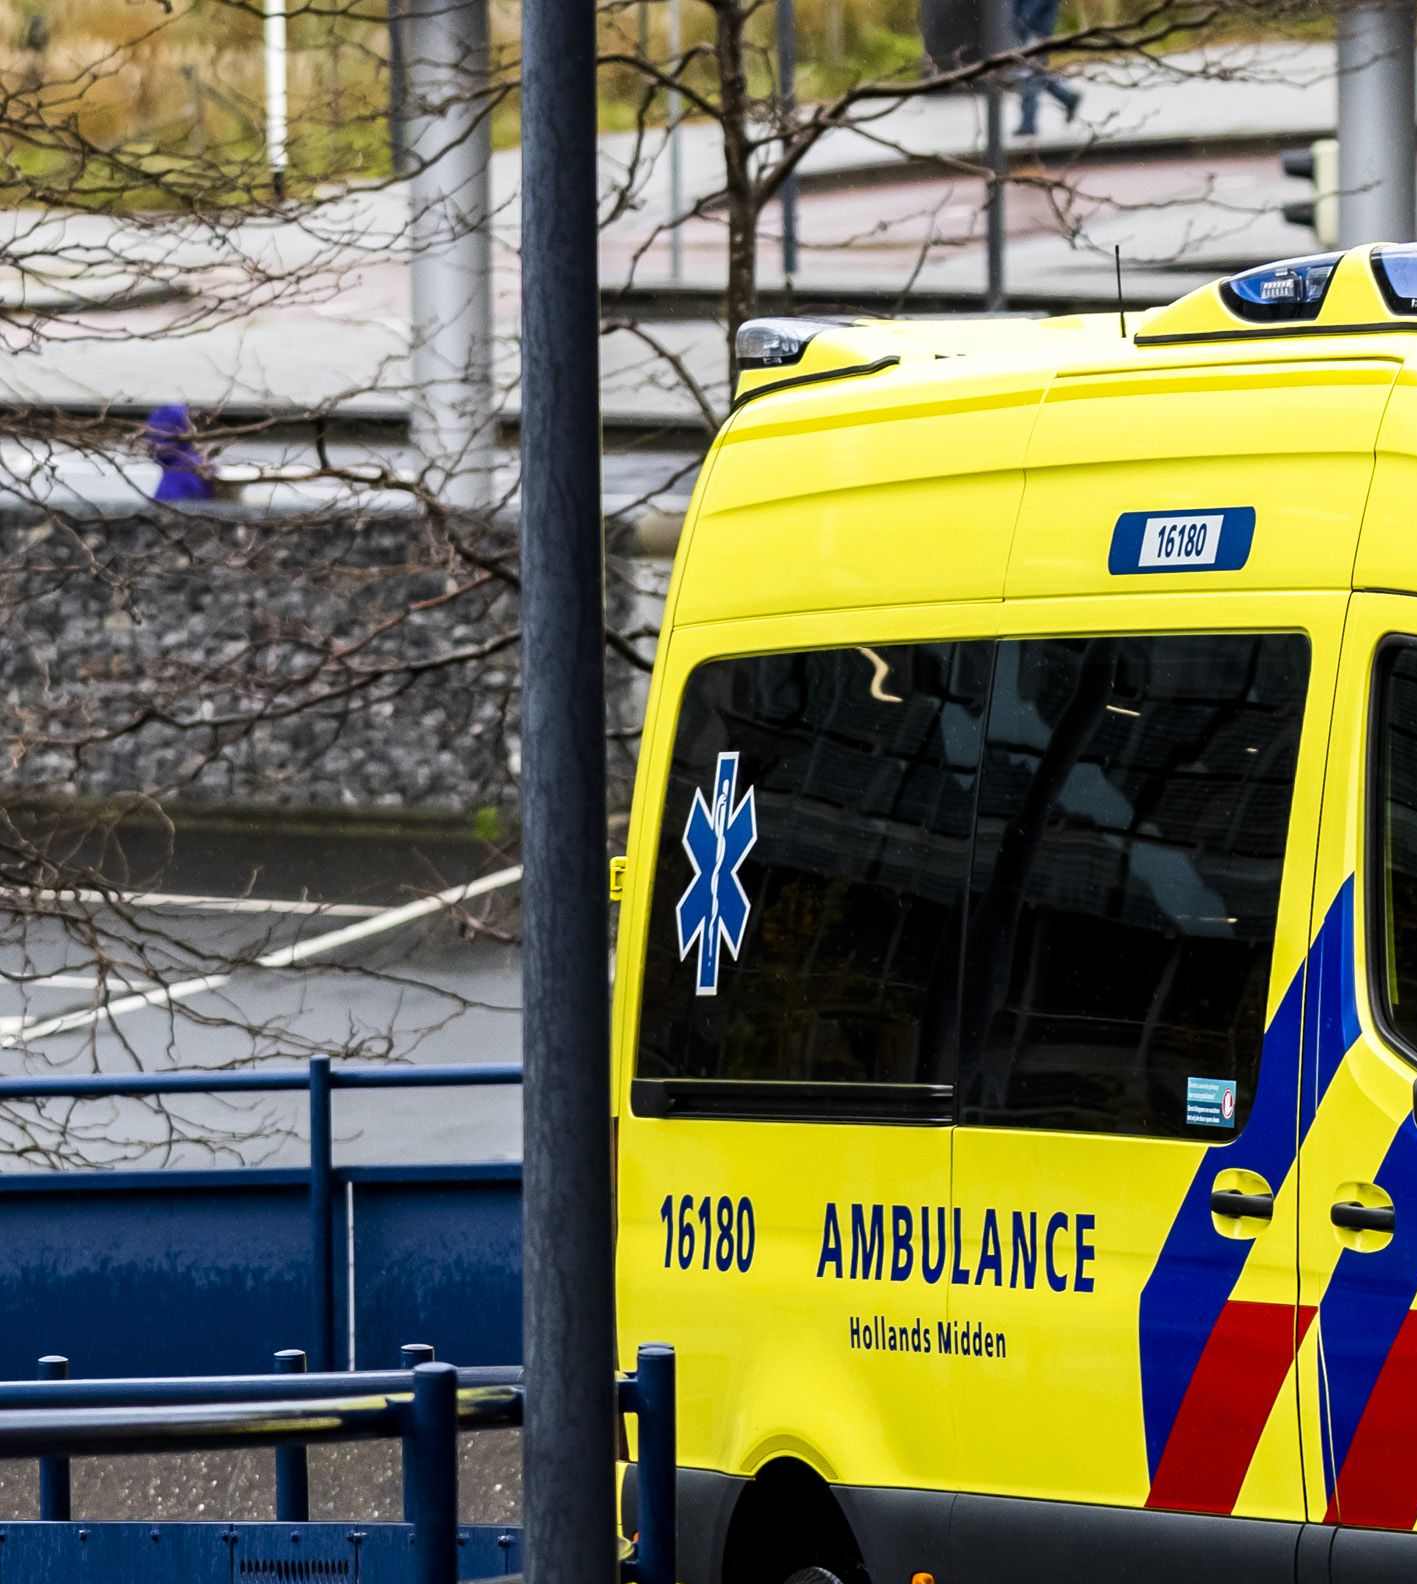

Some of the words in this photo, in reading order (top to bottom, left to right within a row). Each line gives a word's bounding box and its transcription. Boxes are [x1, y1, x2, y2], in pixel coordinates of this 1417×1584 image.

[1156, 522, 1208, 558] 16180
[660, 1194, 755, 1273] 16180
[816, 1202, 1096, 1293] AMBULANCE
[849, 1315, 932, 1353] Hollands
[937, 1320, 1007, 1358] Midden
